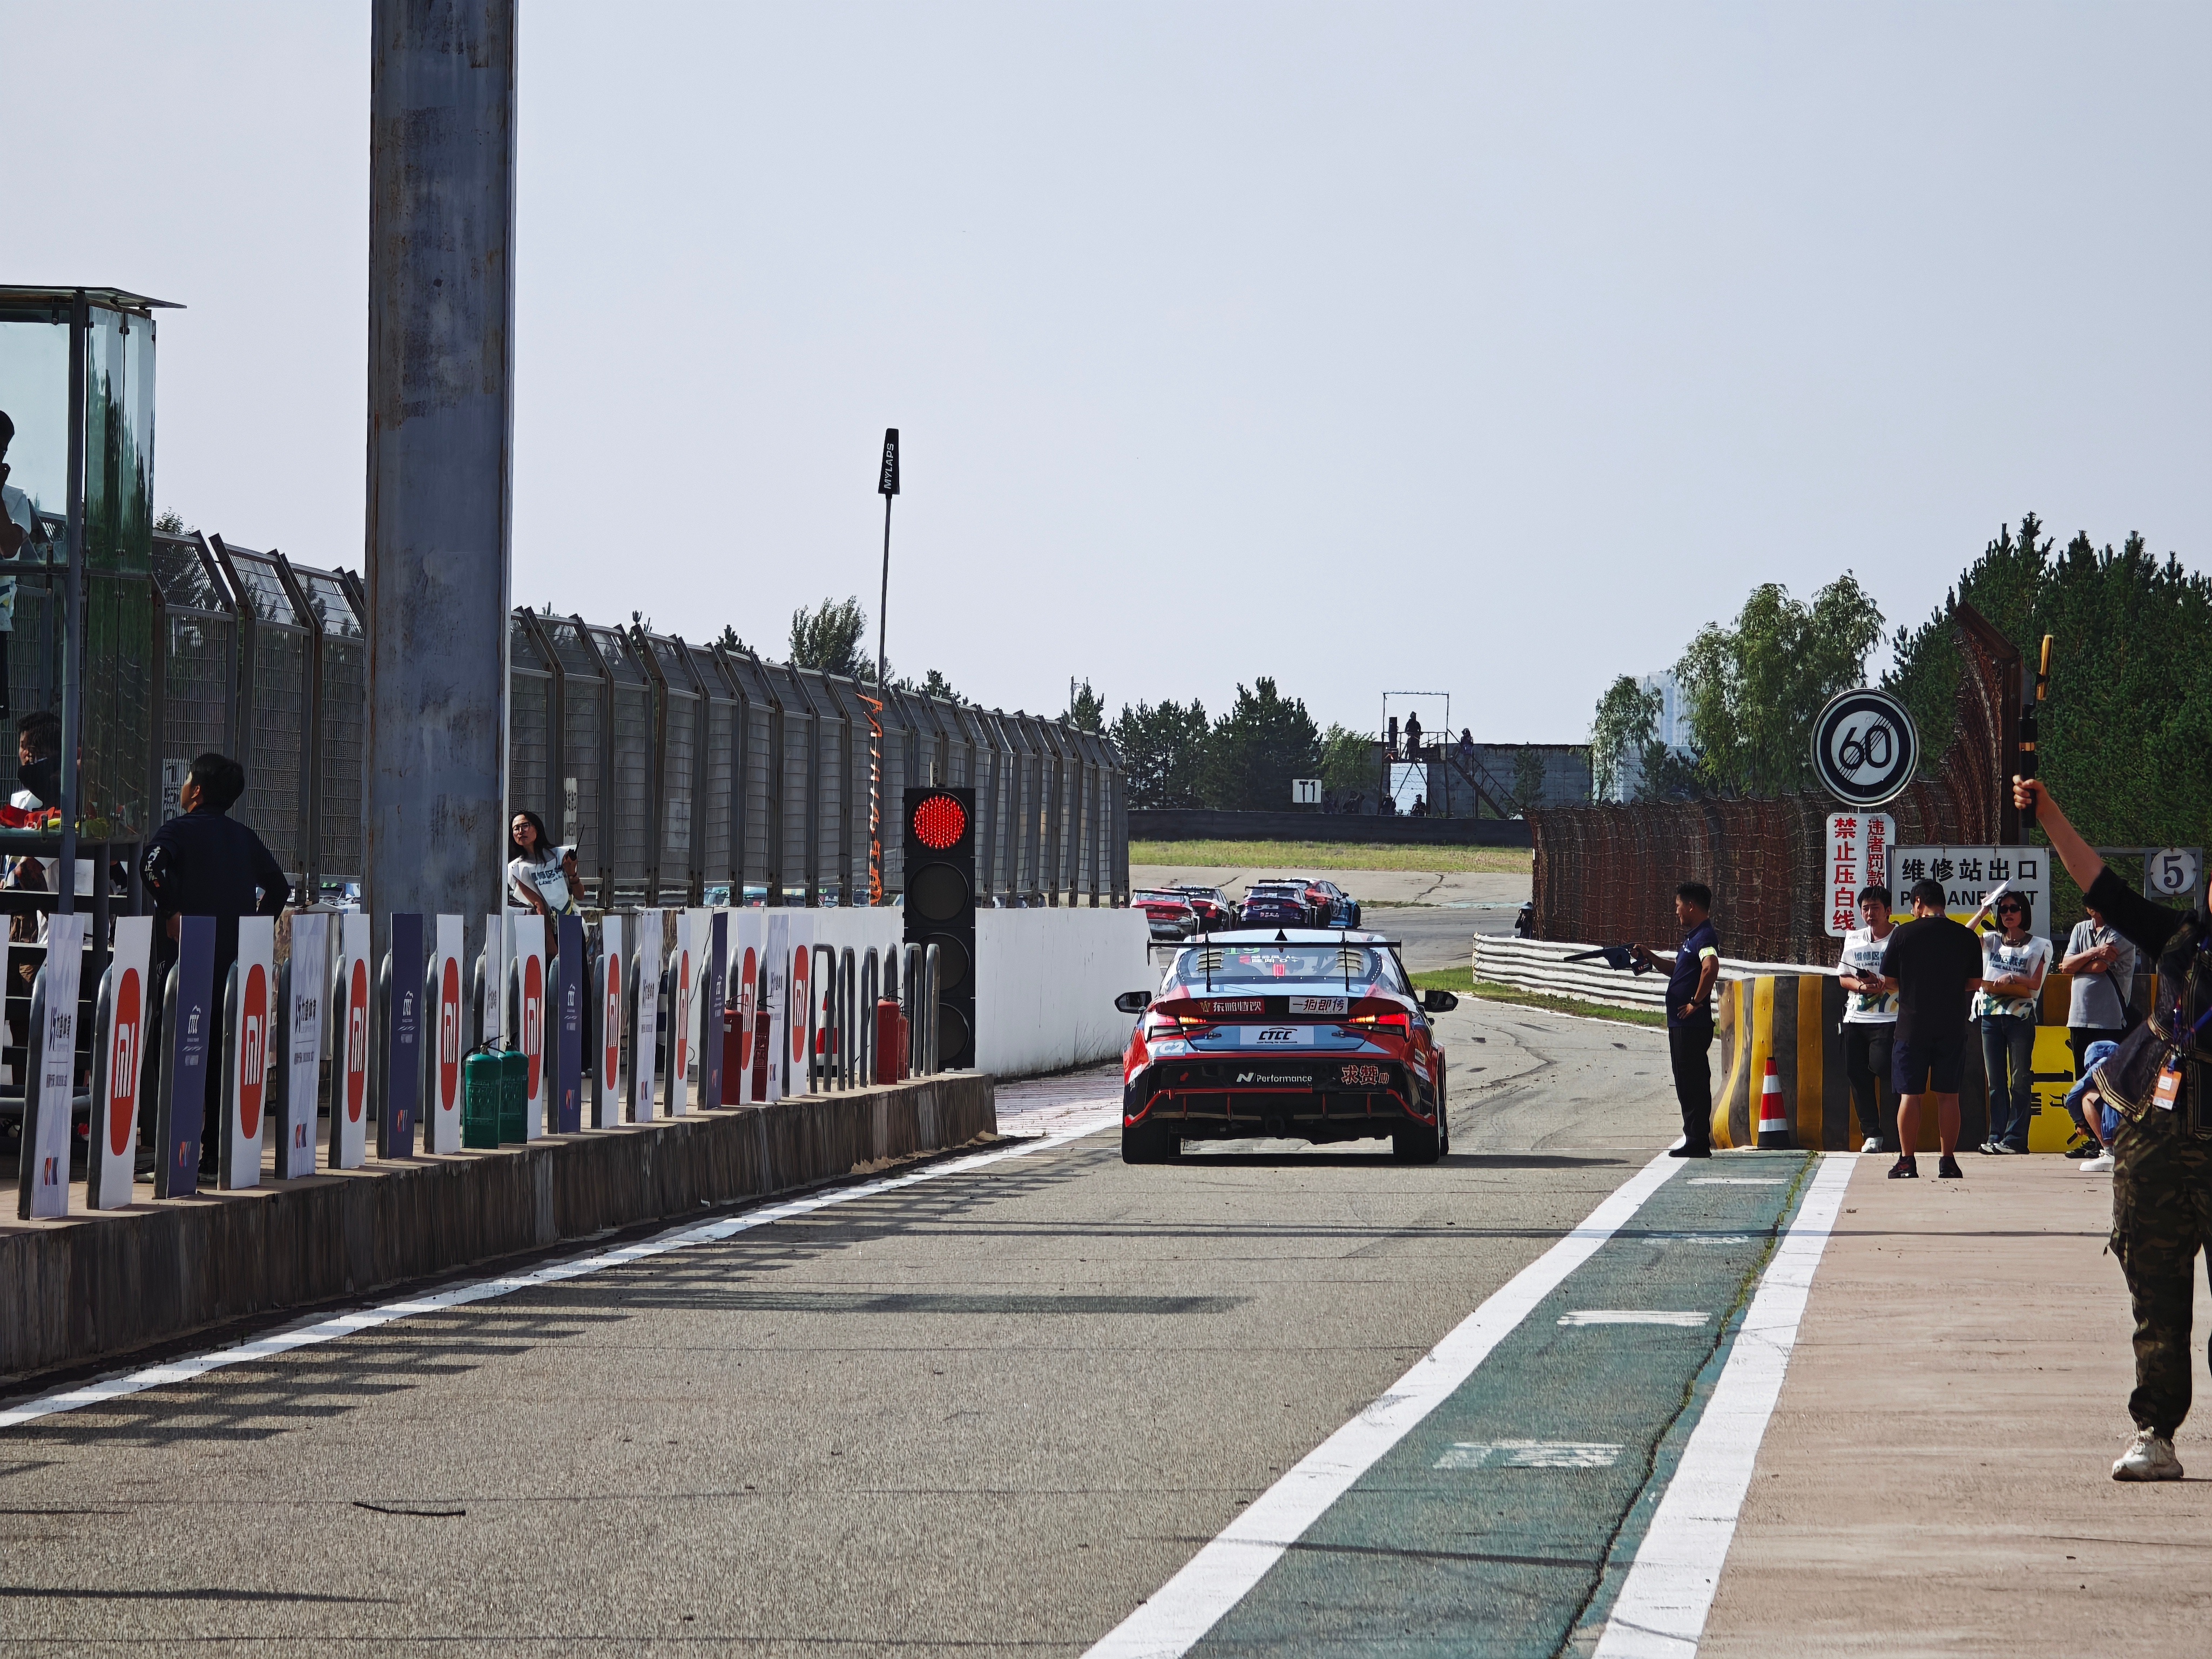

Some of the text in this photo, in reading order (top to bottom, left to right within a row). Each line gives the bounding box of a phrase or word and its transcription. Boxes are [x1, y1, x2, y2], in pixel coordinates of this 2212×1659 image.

[884, 443, 894, 489] MYLAPS
[1838, 726, 1891, 770] 60
[1299, 781, 1316, 802] T1
[1867, 819, 1885, 887] 违者罚款
[1832, 817, 1857, 931] 禁止压白线
[1901, 858, 2037, 882] 维修站出口
[2163, 855, 2184, 889] 5
[1947, 890, 1988, 906] ANE
[1148, 1042, 1185, 1056] TC2
[1259, 1031, 1292, 1040] CTCC
